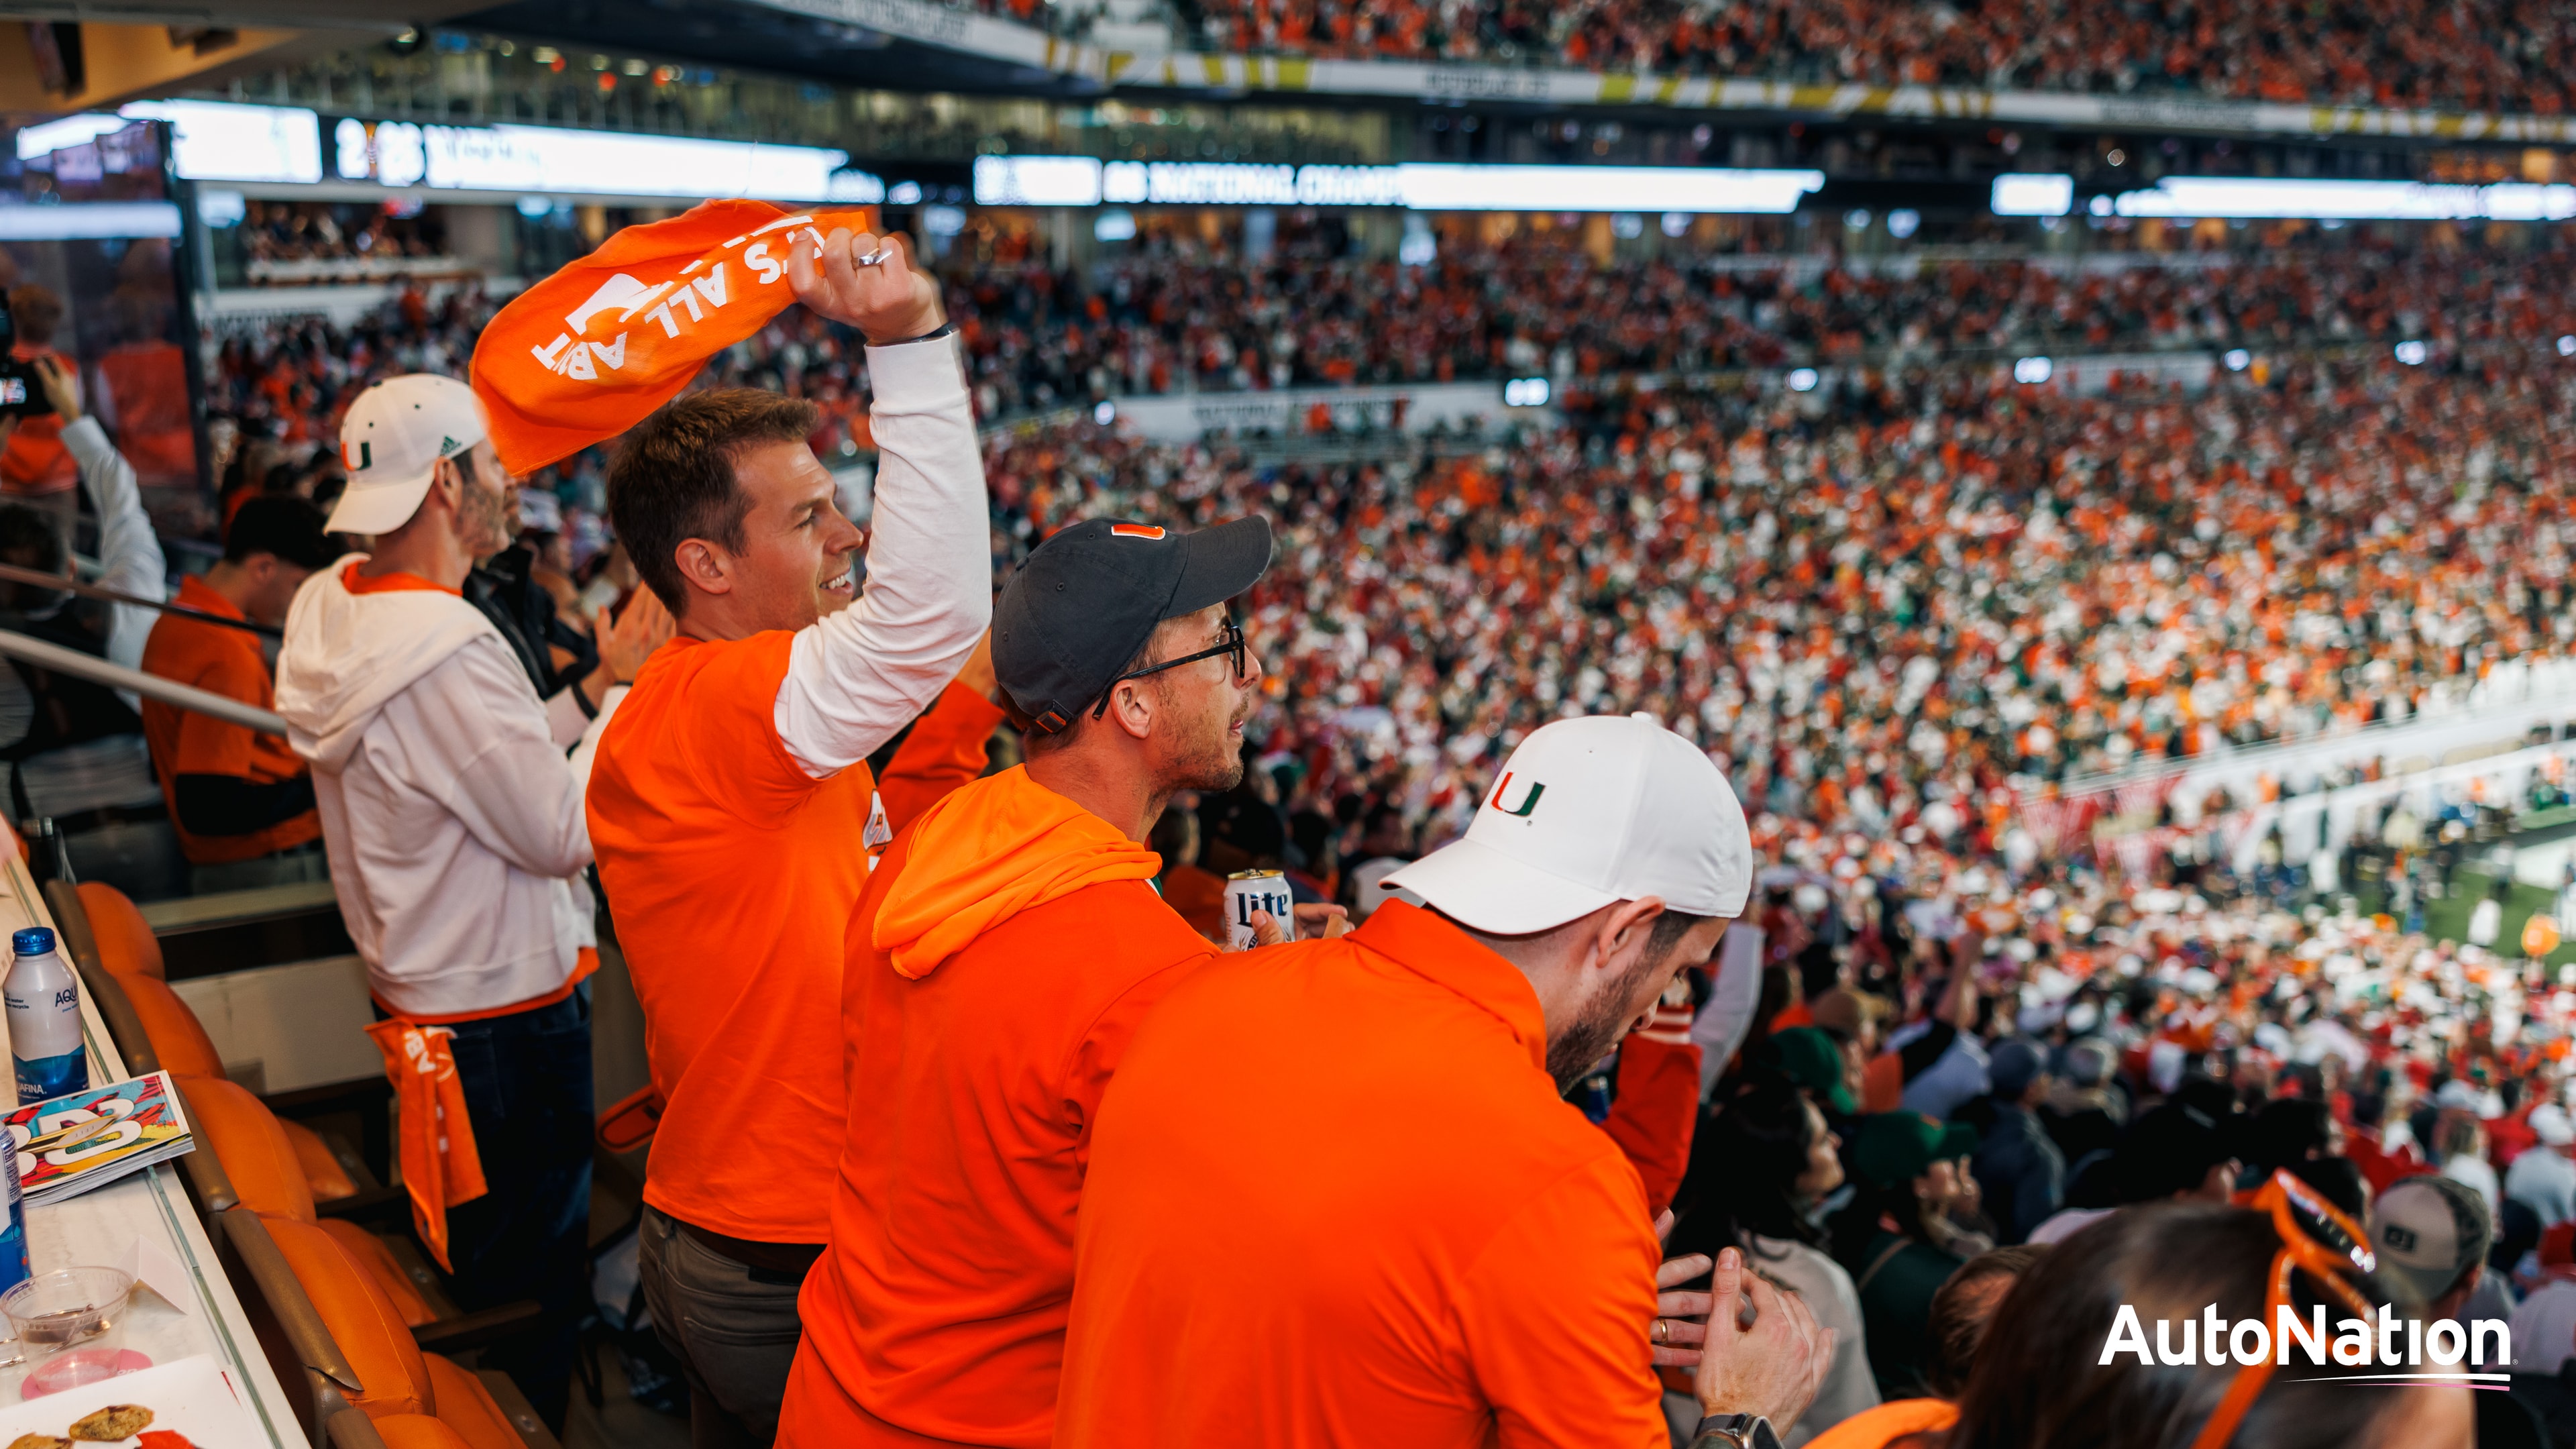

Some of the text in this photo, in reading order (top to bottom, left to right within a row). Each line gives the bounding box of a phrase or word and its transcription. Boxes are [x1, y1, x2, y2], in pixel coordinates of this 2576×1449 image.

[643, 262, 728, 339] ALL
[341, 441, 372, 472] U
[1491, 771, 1546, 818] U
